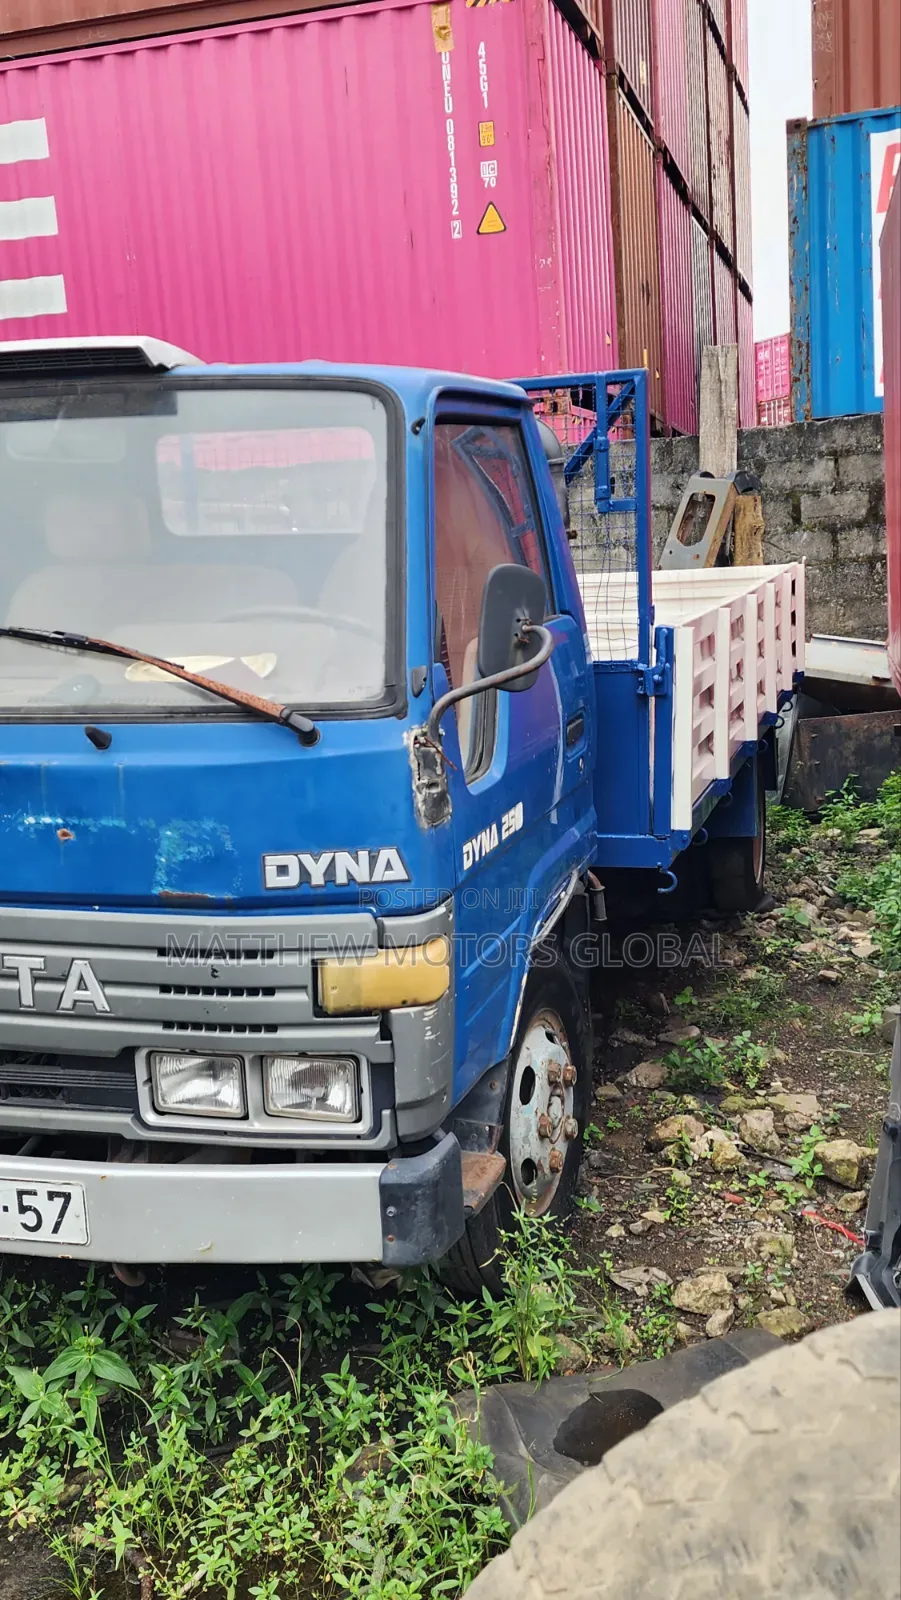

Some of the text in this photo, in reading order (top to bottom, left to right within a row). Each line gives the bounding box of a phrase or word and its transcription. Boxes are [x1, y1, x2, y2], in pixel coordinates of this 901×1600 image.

[478, 41, 488, 109] 45G1
[446, 118, 459, 216] 081392
[483, 177, 497, 189] 70
[452, 220, 462, 239] 2
[462, 801, 524, 871] DYNA 250
[262, 847, 411, 890] DYNA
